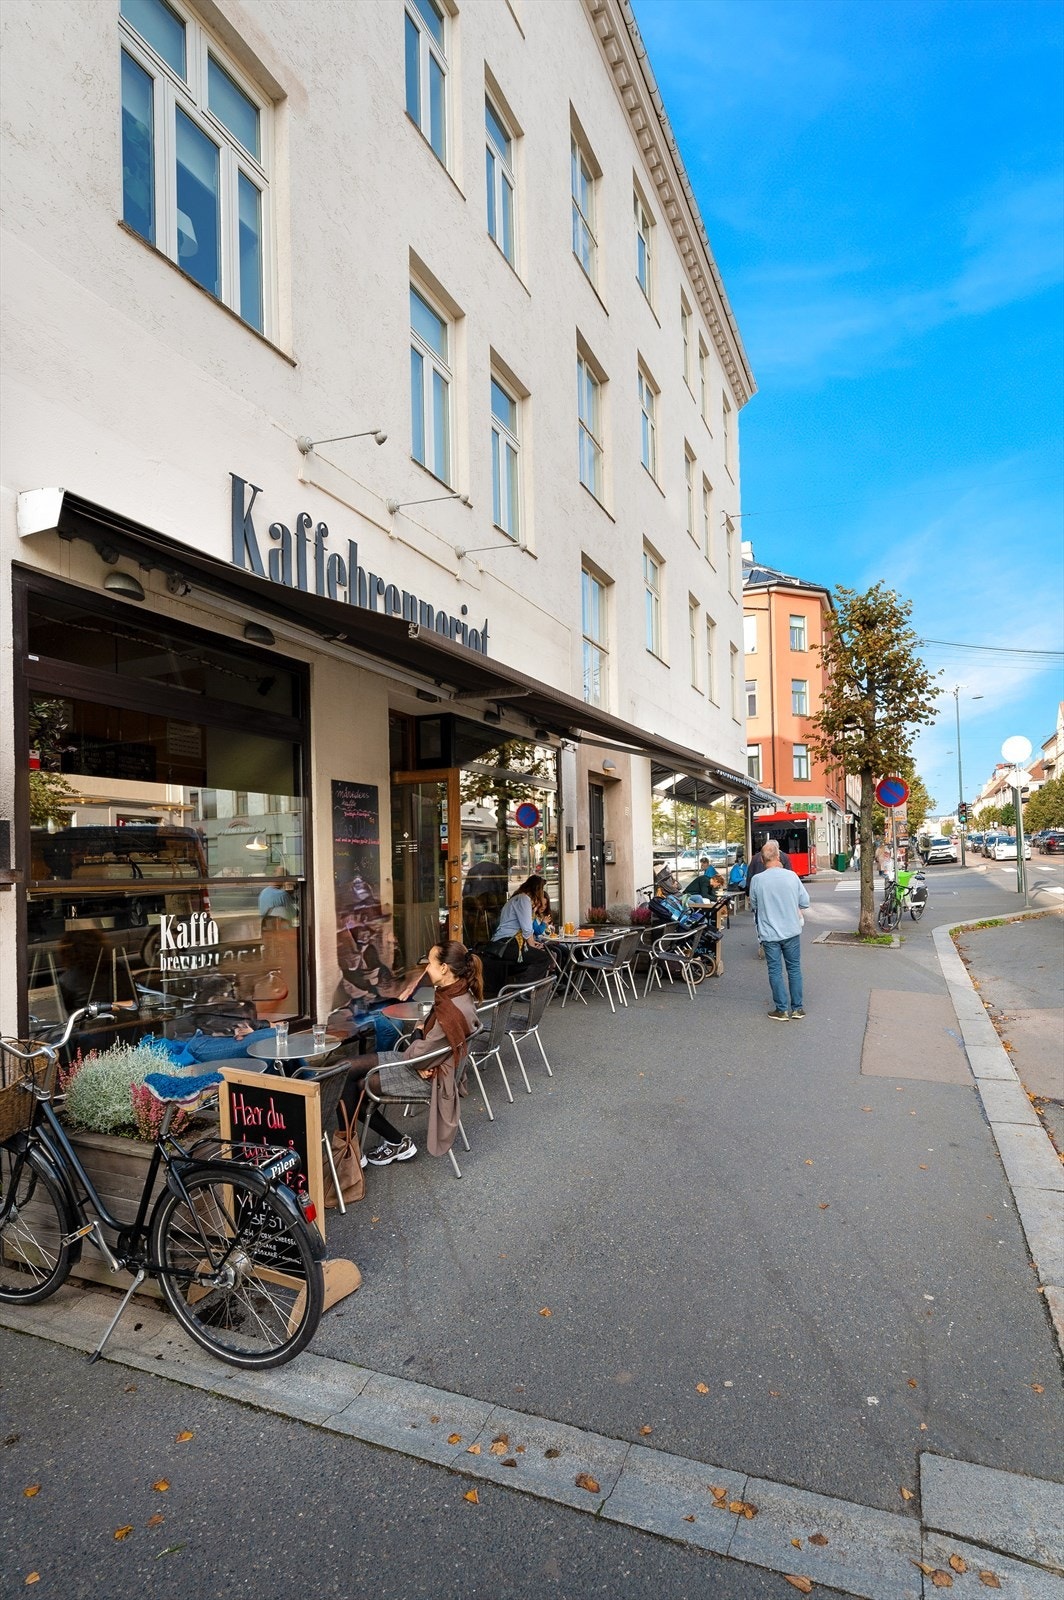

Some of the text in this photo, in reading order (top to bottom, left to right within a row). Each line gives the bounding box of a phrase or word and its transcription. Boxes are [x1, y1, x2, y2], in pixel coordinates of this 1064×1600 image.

[232, 1092, 287, 1130] Har du
[270, 1158, 296, 1180] Pilen
